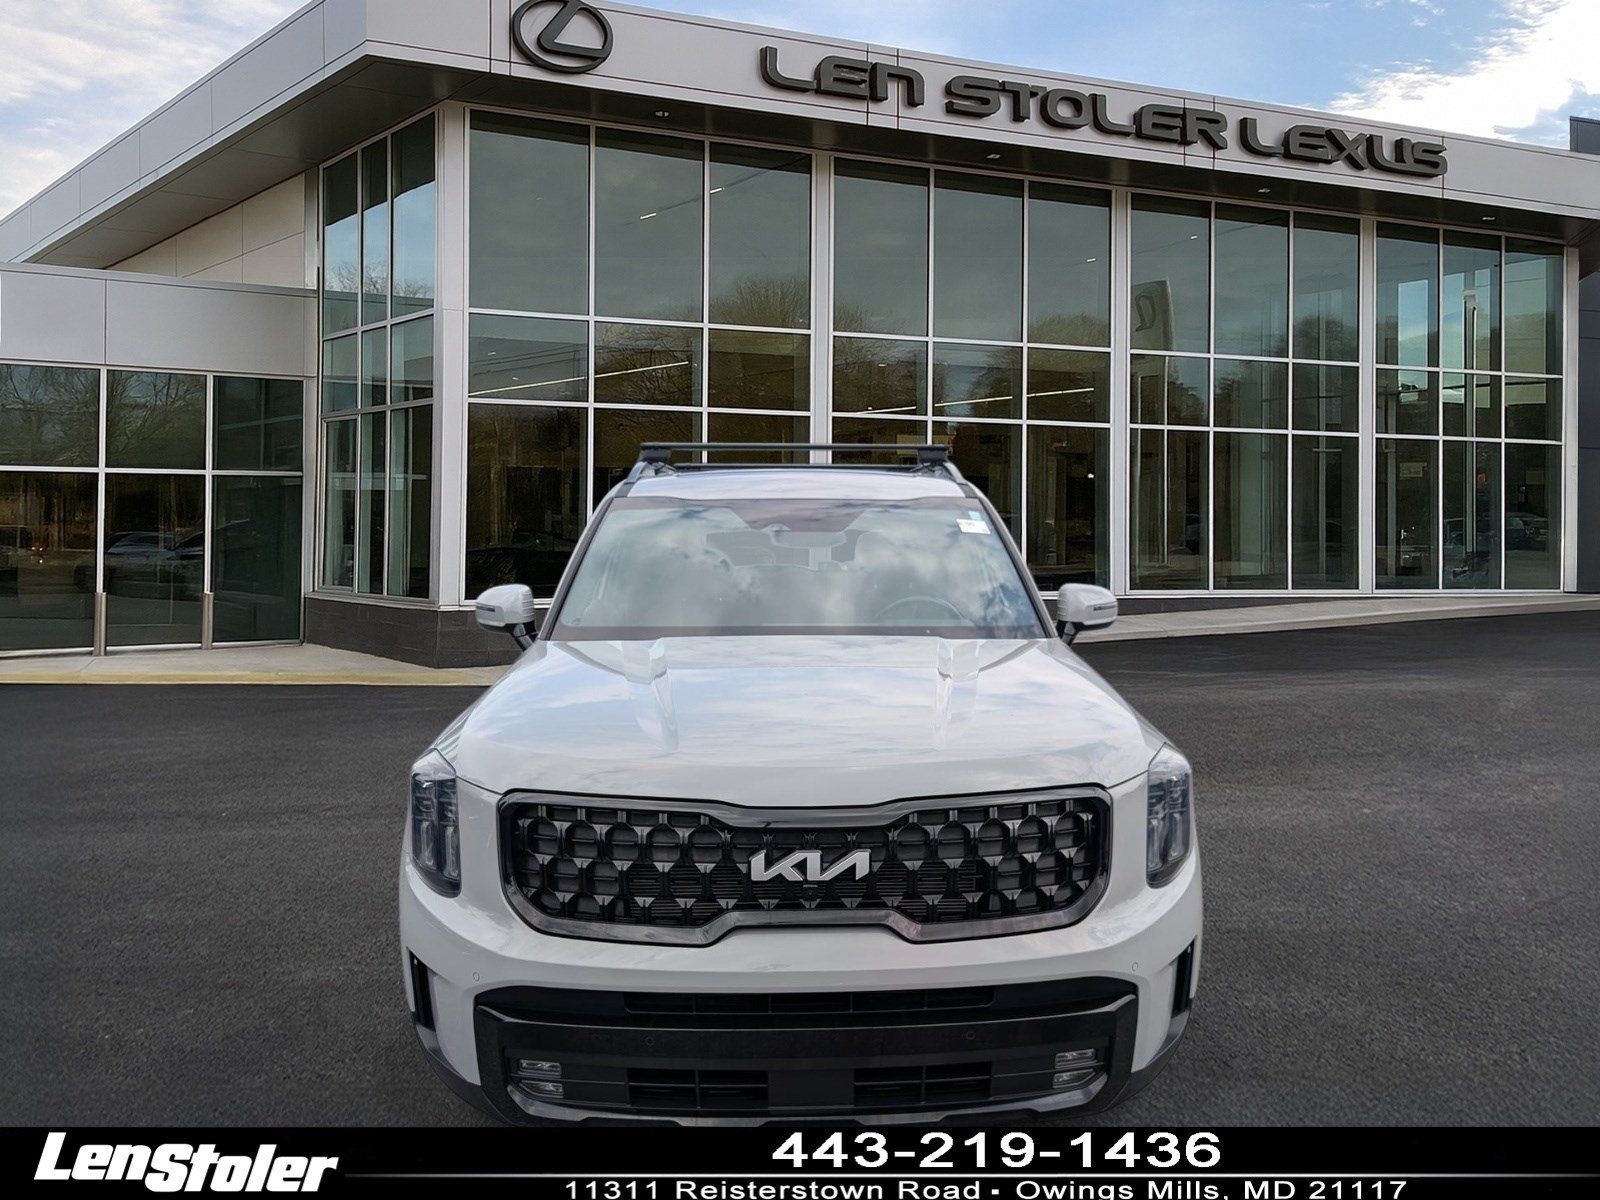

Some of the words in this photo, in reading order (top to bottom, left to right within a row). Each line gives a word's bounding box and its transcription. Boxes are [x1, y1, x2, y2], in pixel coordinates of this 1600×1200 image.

[945, 75, 1228, 150] STOLER
[1240, 117, 1448, 177] LEXUS
[749, 848, 871, 881] KIA
